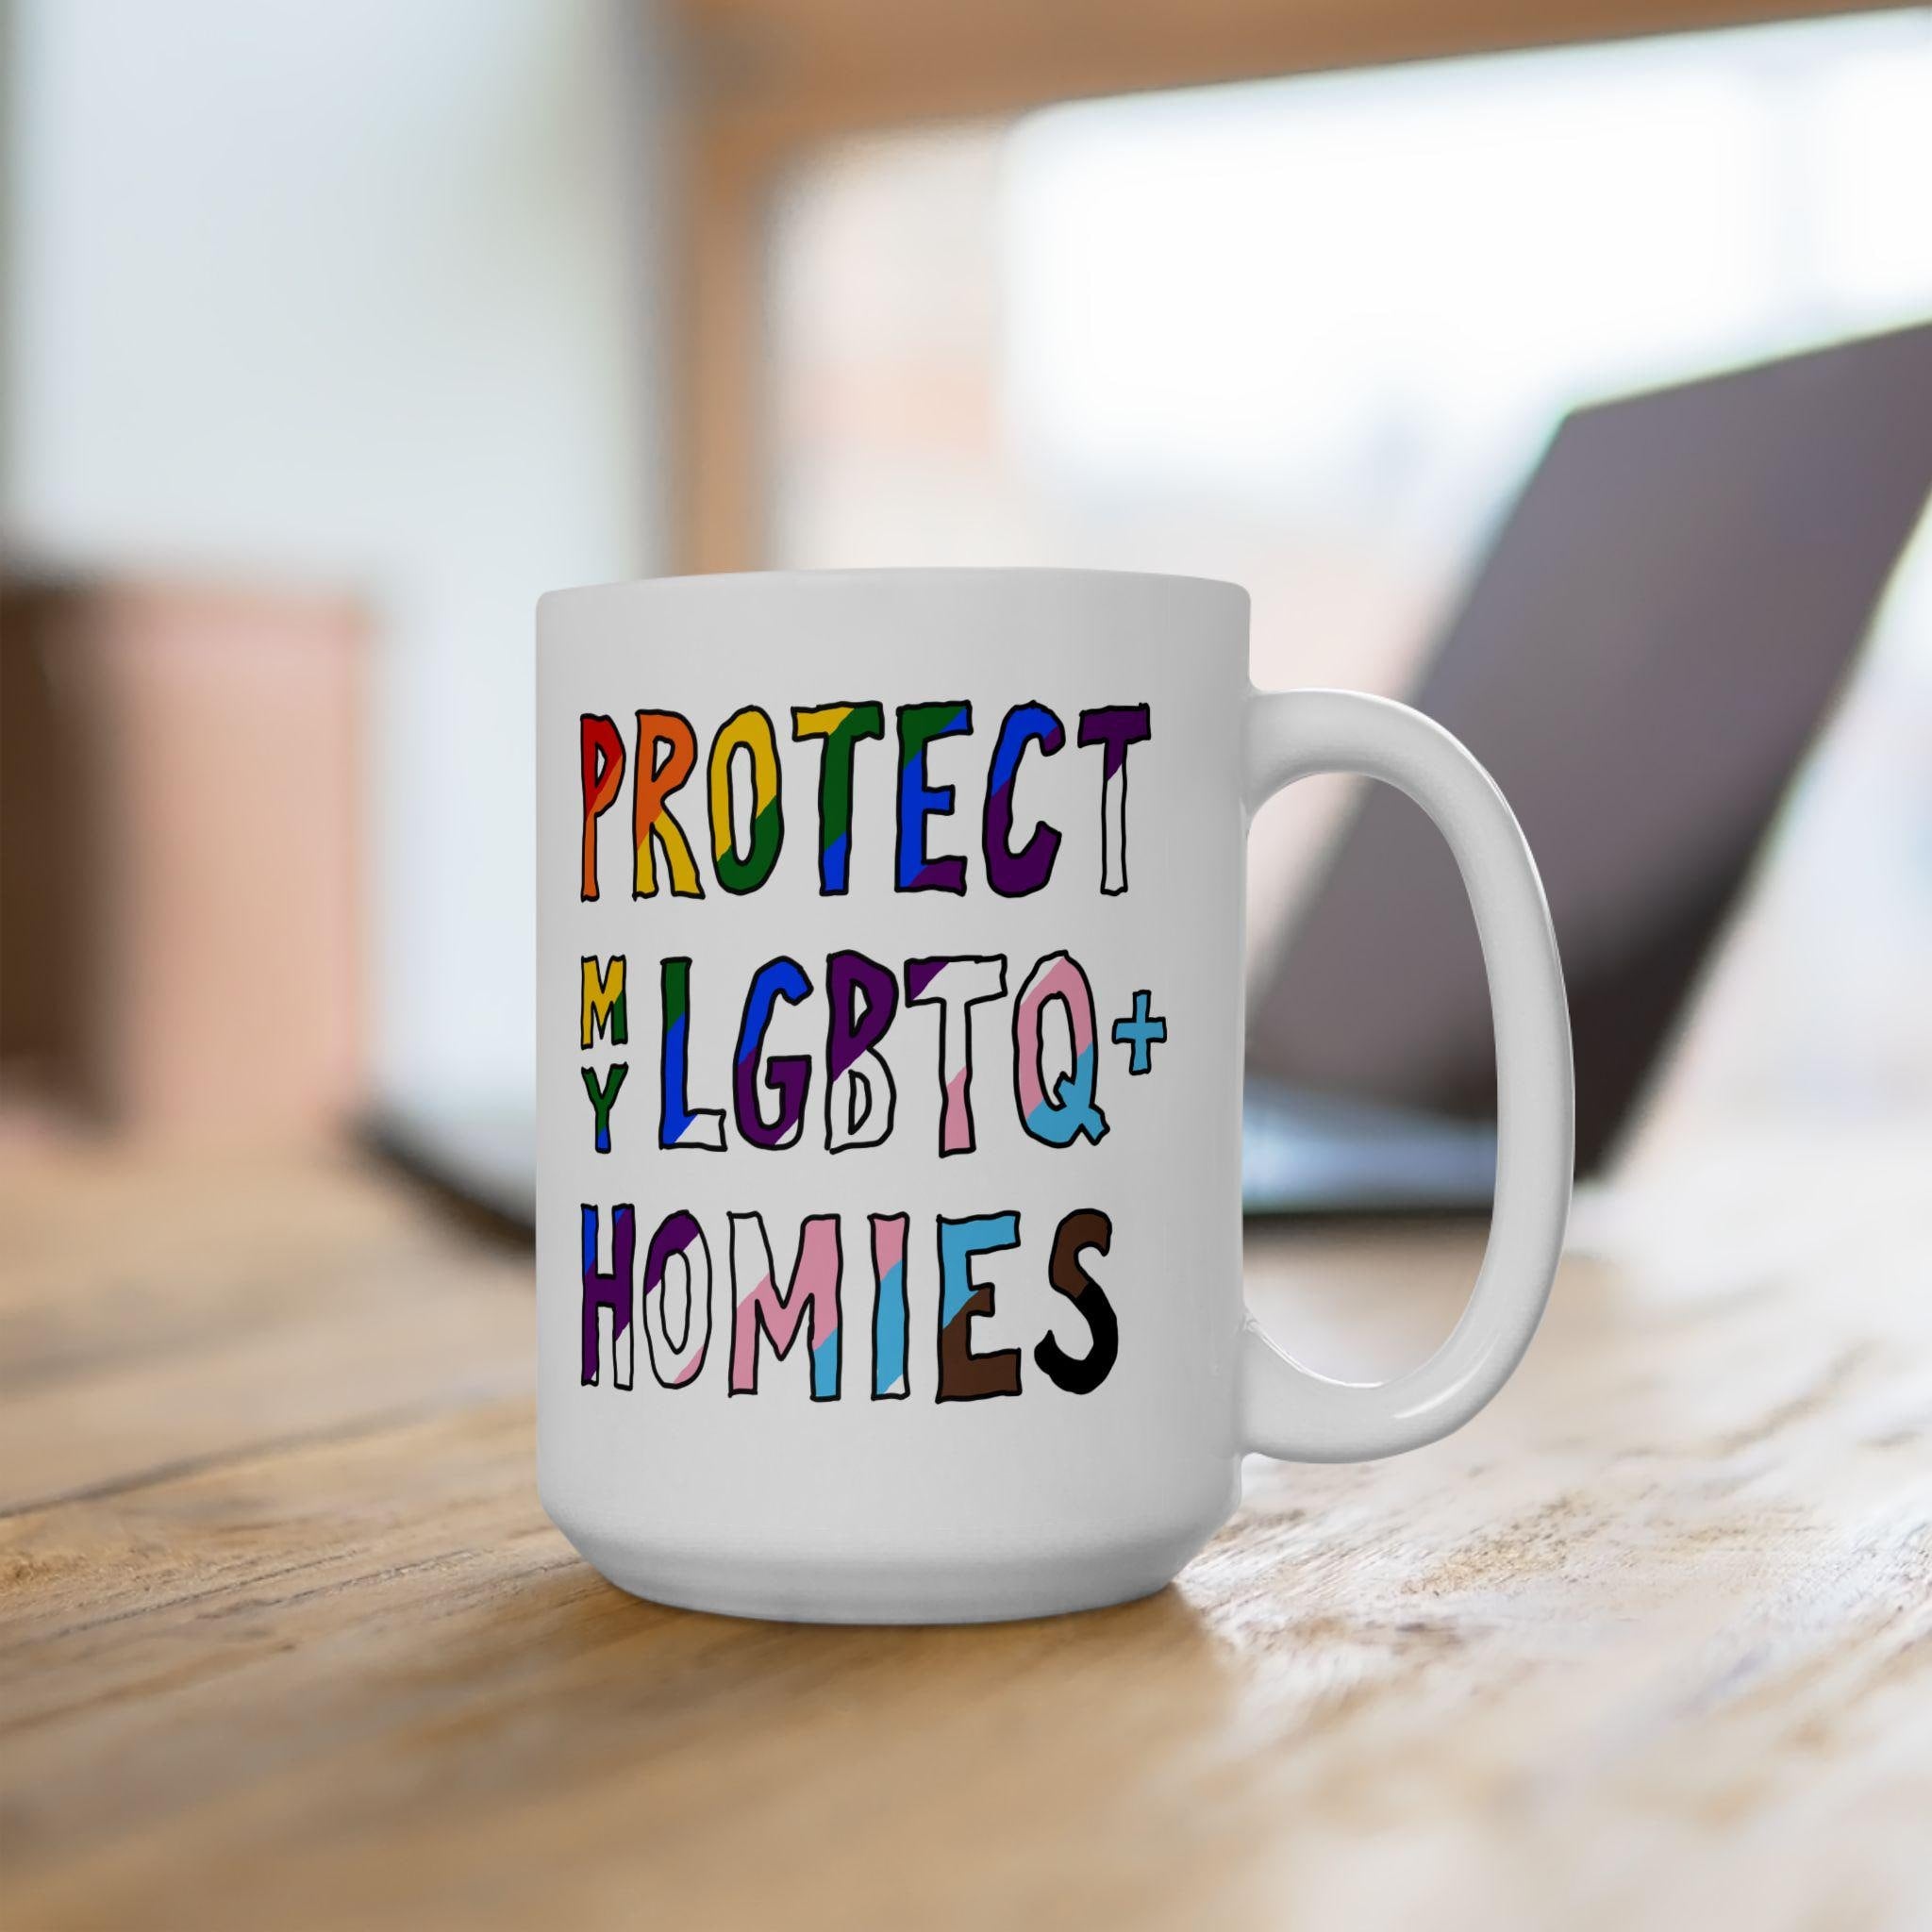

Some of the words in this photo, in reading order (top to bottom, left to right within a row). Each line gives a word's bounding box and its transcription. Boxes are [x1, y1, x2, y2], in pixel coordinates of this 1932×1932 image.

[580, 700, 1151, 903] PROTECT
[580, 955, 629, 1155] MY
[658, 949, 1167, 1158] LGBTQ+
[580, 1203, 1119, 1405] HOMIES
